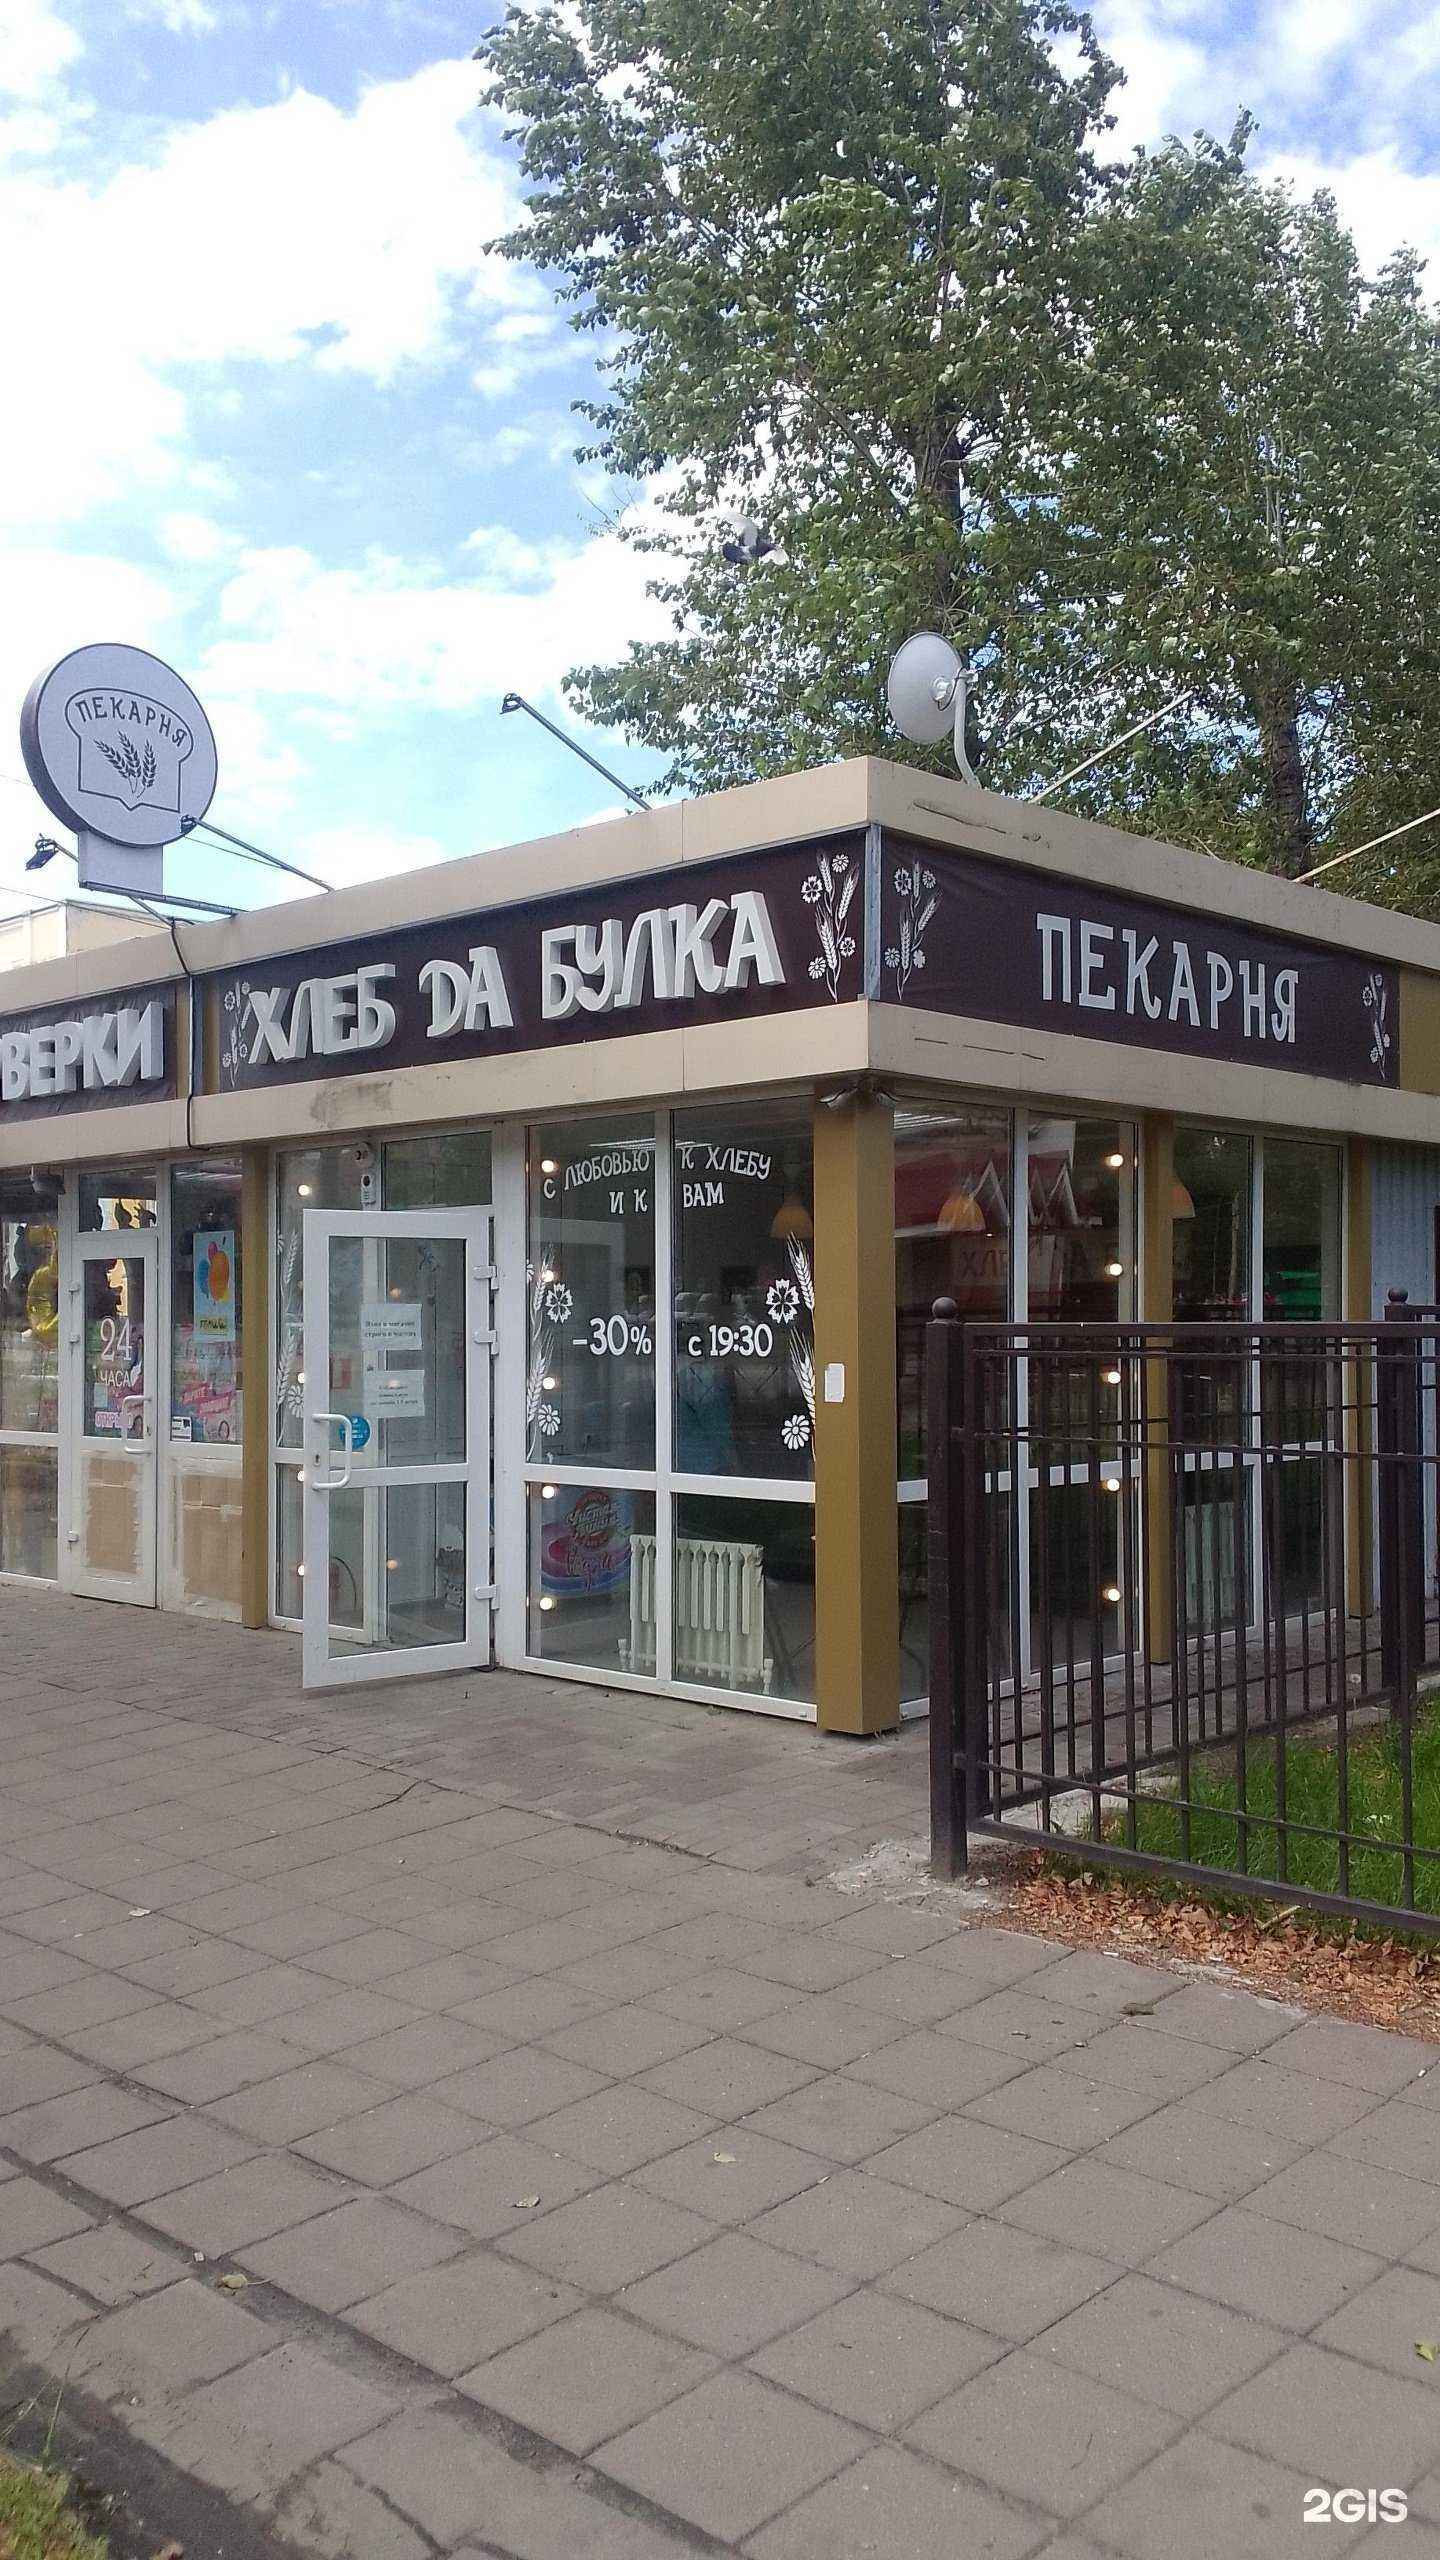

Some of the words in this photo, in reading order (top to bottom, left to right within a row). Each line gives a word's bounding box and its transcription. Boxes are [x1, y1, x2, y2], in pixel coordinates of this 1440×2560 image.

[75, 696, 188, 748] ПЕКАРНЯ
[248, 963, 396, 1065] ХЛЕБ
[541, 890, 786, 1020] БУЛКА
[1036, 912, 1299, 1044] ПЕКАРНЯ
[0, 1000, 164, 1101] ВЕРКИ
[564, 1148, 650, 1191] ЛЮБОВЬЮ
[680, 1147, 695, 1170] К
[705, 1146, 772, 1180] ХЛЕБУ
[609, 1190, 624, 1214] И
[634, 1188, 648, 1213] К
[683, 1181, 725, 1208] ВАМ
[100, 1317, 132, 1362] 24
[572, 1314, 652, 1356] -30%
[709, 1323, 773, 1357] 19:30
[100, 1370, 132, 1387] ЧАСА
